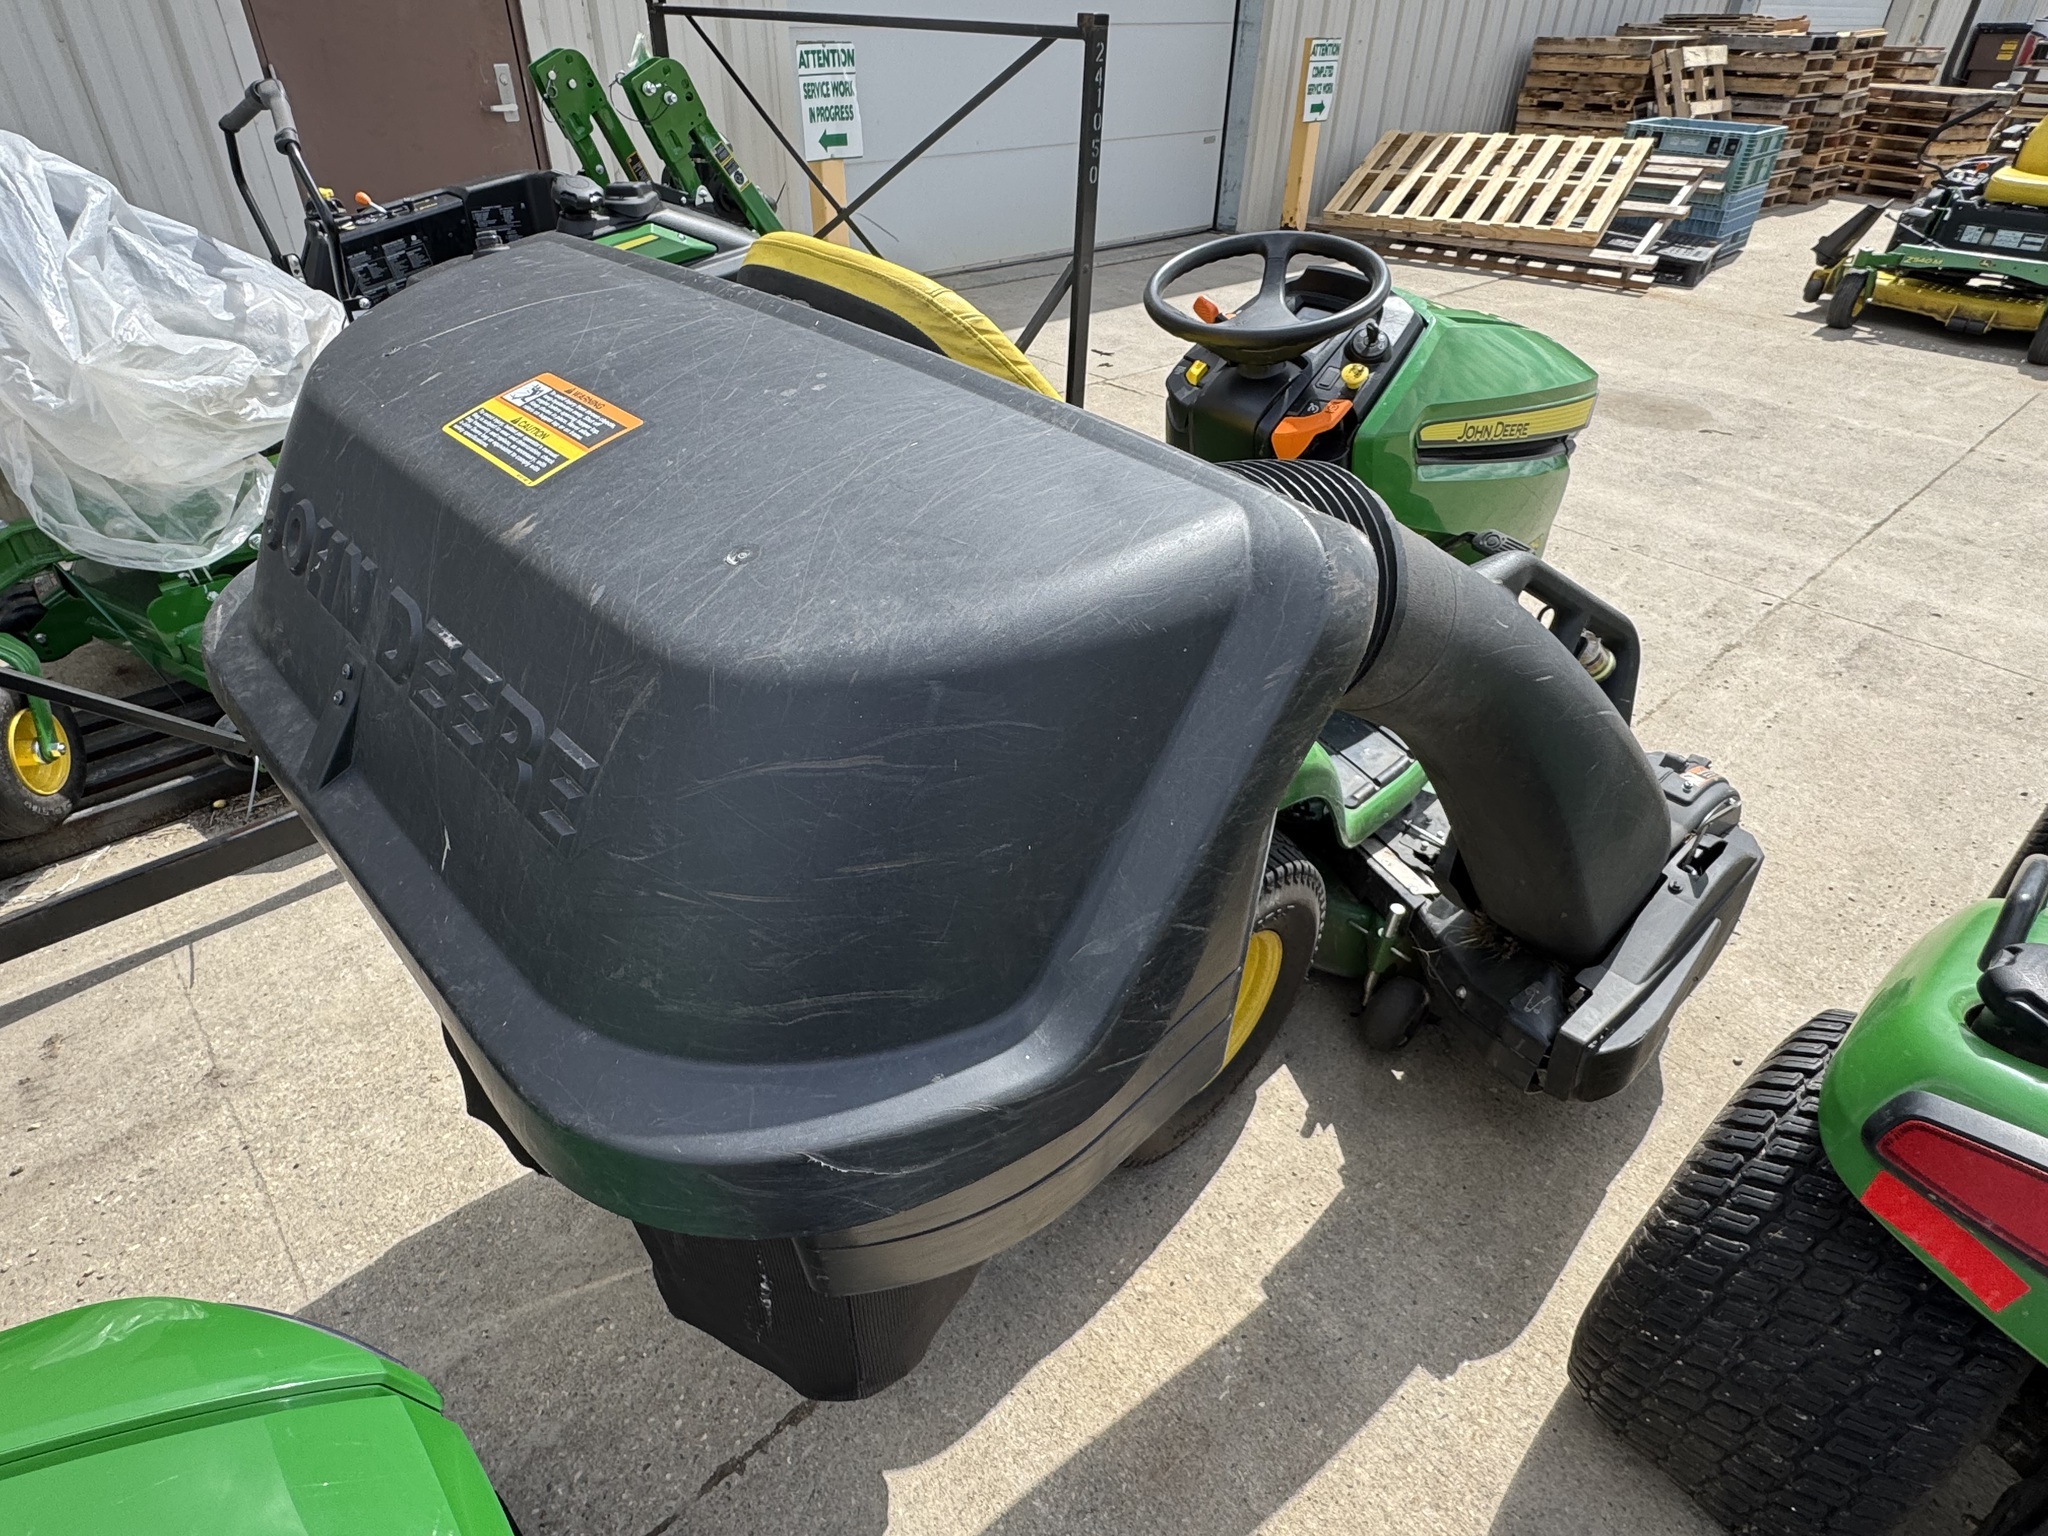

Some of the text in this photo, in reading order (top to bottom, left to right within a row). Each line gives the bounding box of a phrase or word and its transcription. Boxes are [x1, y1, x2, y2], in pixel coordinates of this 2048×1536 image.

[799, 48, 855, 69] ATTENTION
[1311, 43, 1341, 57] ATTENTION
[803, 80, 855, 100] SERVICE WORK
[809, 104, 854, 124] IN PROGRESS
[573, 391, 606, 411] WARNING
[518, 419, 550, 441] CAUTION
[1457, 421, 1530, 441] JOHN DEERE
[263, 482, 600, 853] JOHN DEERE
